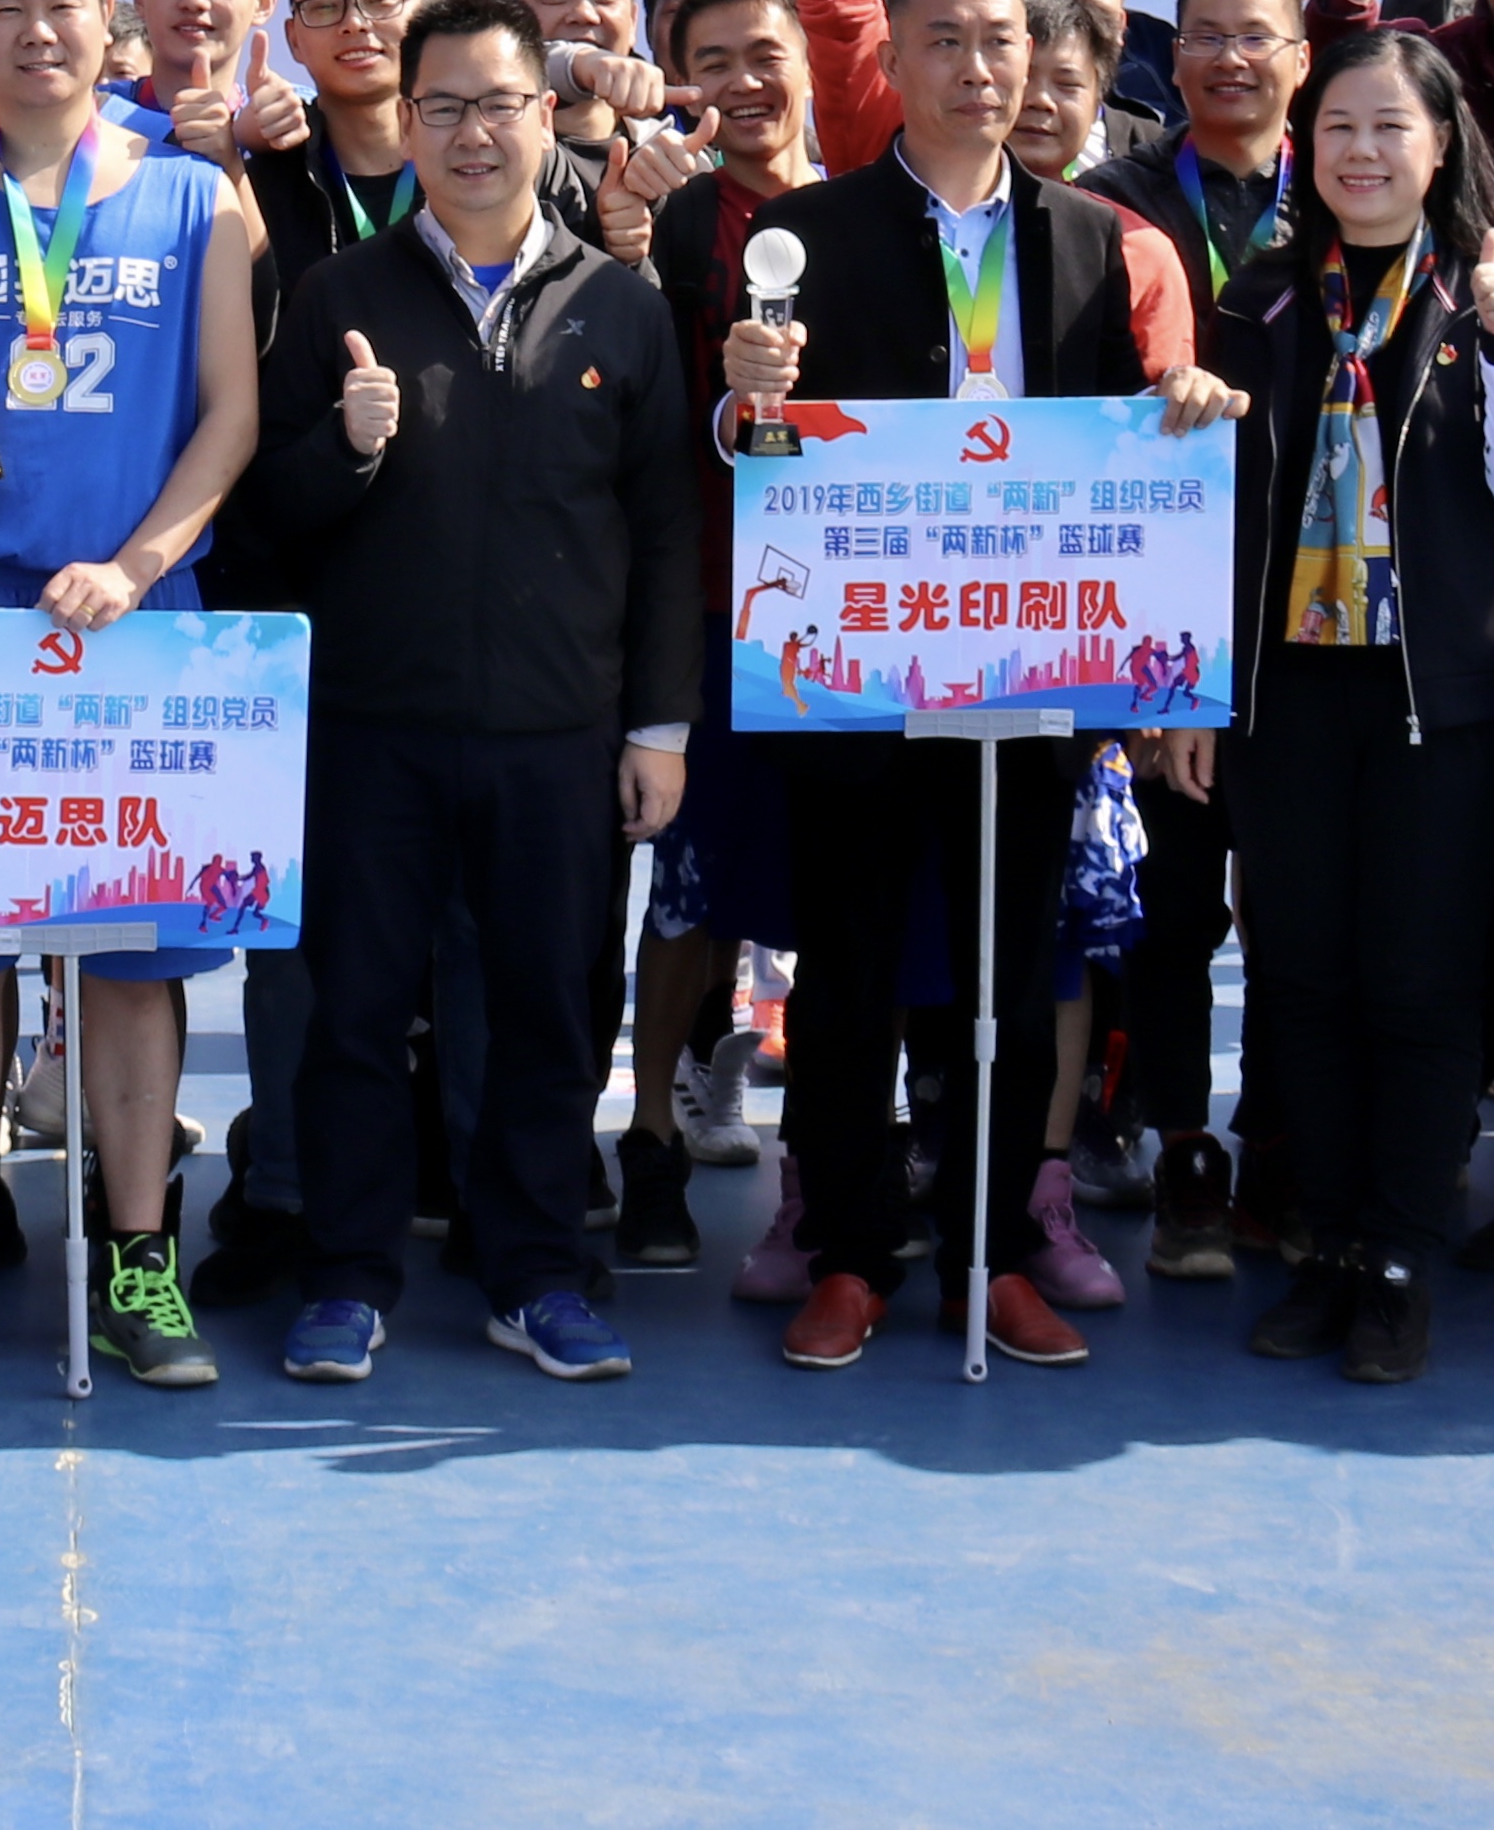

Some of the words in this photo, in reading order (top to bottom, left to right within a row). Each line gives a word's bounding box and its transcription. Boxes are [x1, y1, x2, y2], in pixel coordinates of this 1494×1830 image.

[839, 579, 1127, 633] 星光印刷队
